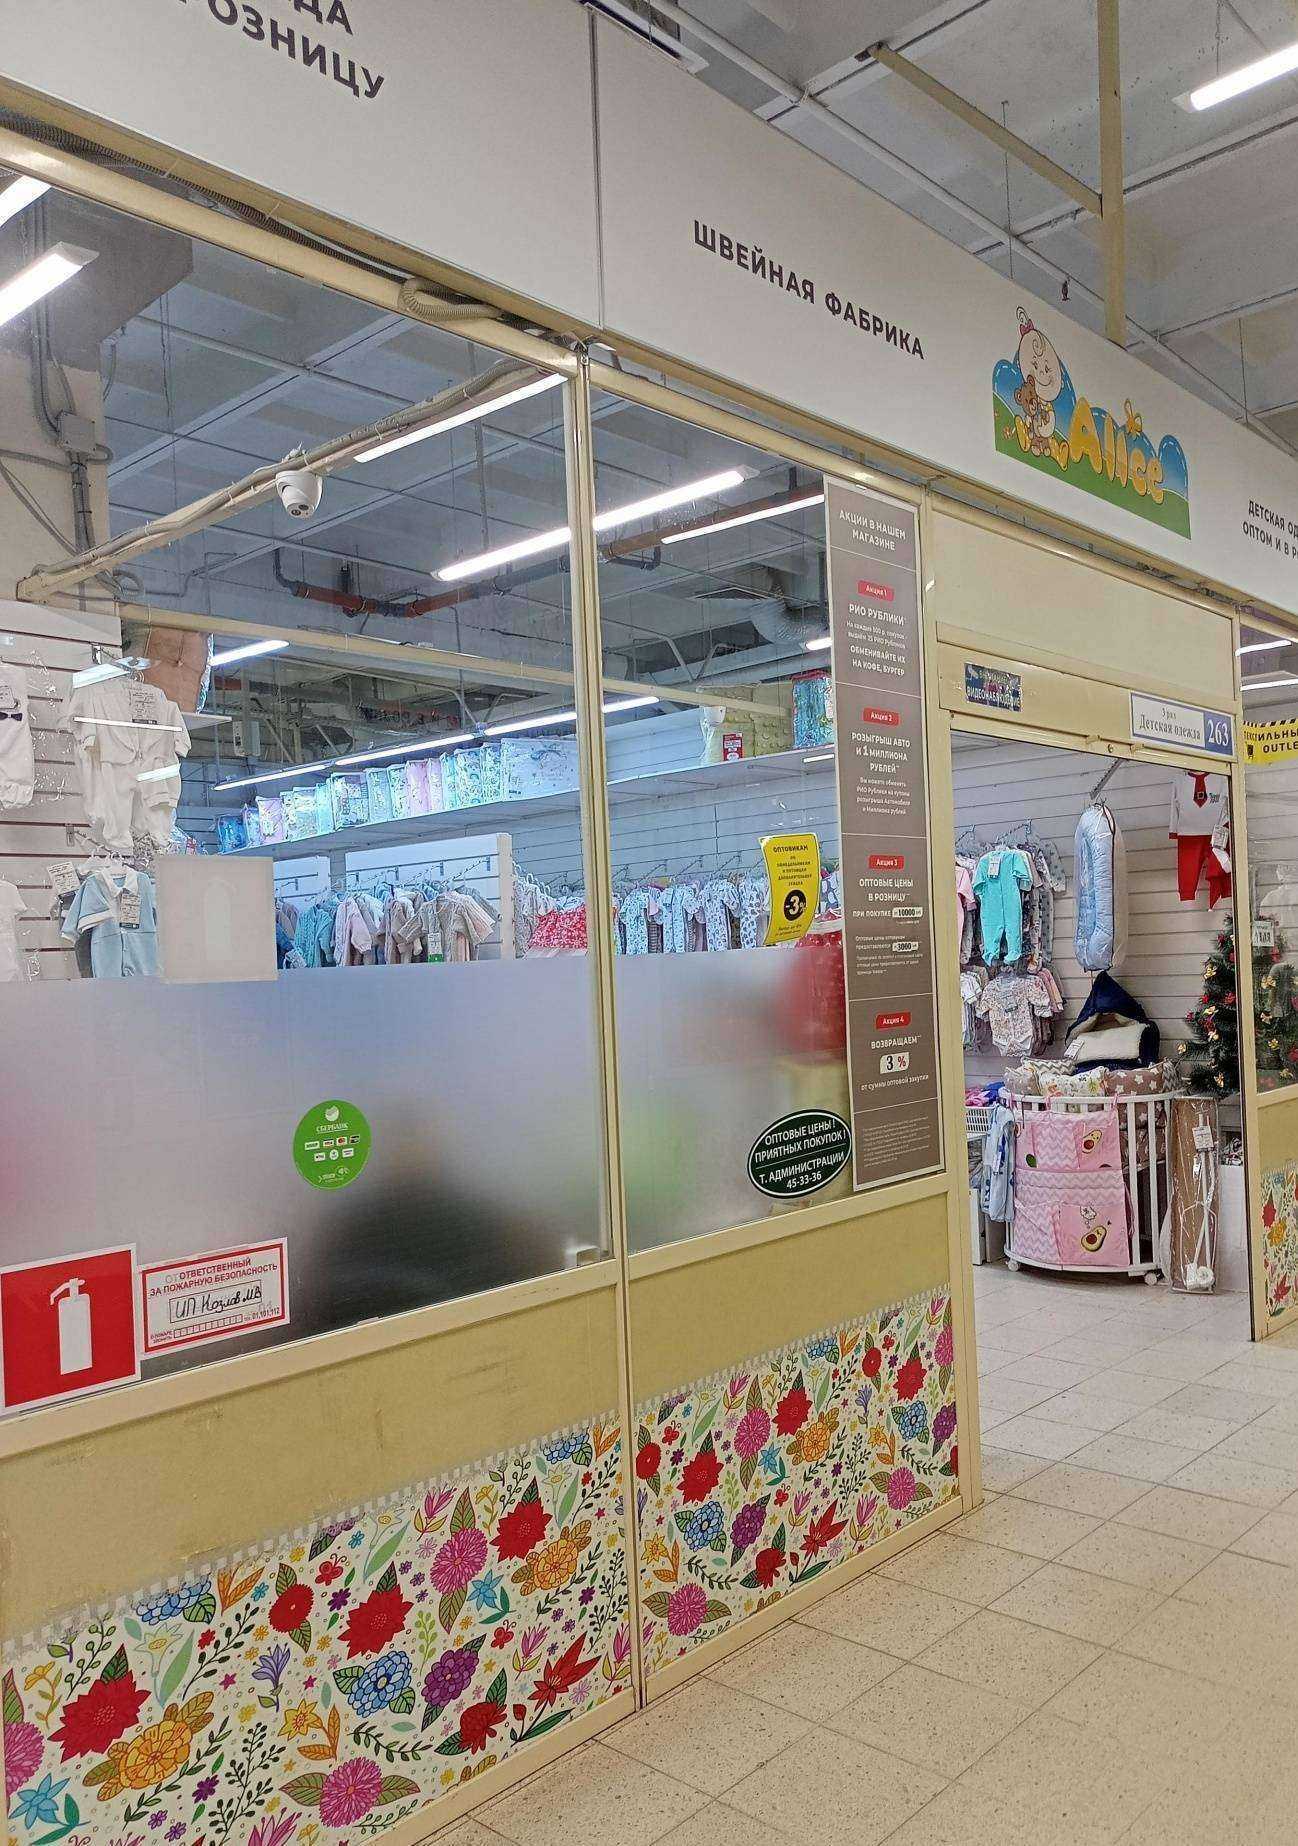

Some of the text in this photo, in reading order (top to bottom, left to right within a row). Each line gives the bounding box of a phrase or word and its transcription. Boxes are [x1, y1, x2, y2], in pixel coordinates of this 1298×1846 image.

[206, 0, 385, 99] ОЗНИЦУ
[694, 219, 925, 360] ШВЕЙНАЯ ФАБРИКА
[1069, 397, 1164, 504] Alice
[839, 509, 906, 540] АКЦИИ В НАШЕМ
[1249, 500, 1285, 531] ДЕТСКАЯ
[852, 529, 896, 551] МАГАЗИНЕ
[1242, 521, 1298, 559] ОПТОМ И В Р
[865, 584, 884, 596] Акция
[849, 603, 866, 616] РИО
[850, 644, 906, 664] ОБМЕНИВАЙТЕ ИХ
[852, 658, 905, 676] НА КОФЕ, БУРГЕР
[870, 711, 893, 722] Акция 2
[1140, 714, 1201, 740] Детская одежда
[1207, 719, 1229, 747] 263
[851, 732, 911, 748] РОЗЫГРЫШ АВТО
[855, 745, 908, 761] И 1 МИЛЛИОНА
[773, 844, 809, 853] ОПТОВИКАМ
[876, 859, 894, 867] Акция
[859, 878, 914, 889] ОПТОВЫЕ ЦЕНЫ
[868, 893, 906, 902] В РОЗНИЦУ
[866, 910, 892, 918] ПОКУПКЕ
[898, 908, 916, 917] 10000
[897, 942, 912, 951] 3000
[882, 1015, 905, 1025] Акция 4
[871, 1036, 917, 1050] ВОЗВРАЩАЕМ
[886, 1055, 906, 1071] 3 %
[765, 1125, 807, 1146] ОПТОВЫЕ
[755, 1141, 802, 1163] ПРИЯТНЫХ
[759, 1151, 845, 1184] Т. АДМИНИСТРАЦИИ
[786, 1170, 822, 1189] 45-33-36
[179, 1257, 251, 1280] ОТВЕТСТВЕННЫЙ
[149, 1264, 278, 1297] ЗА ПОЖАРНУЮ БЕЗОПАСНОСТЬ
